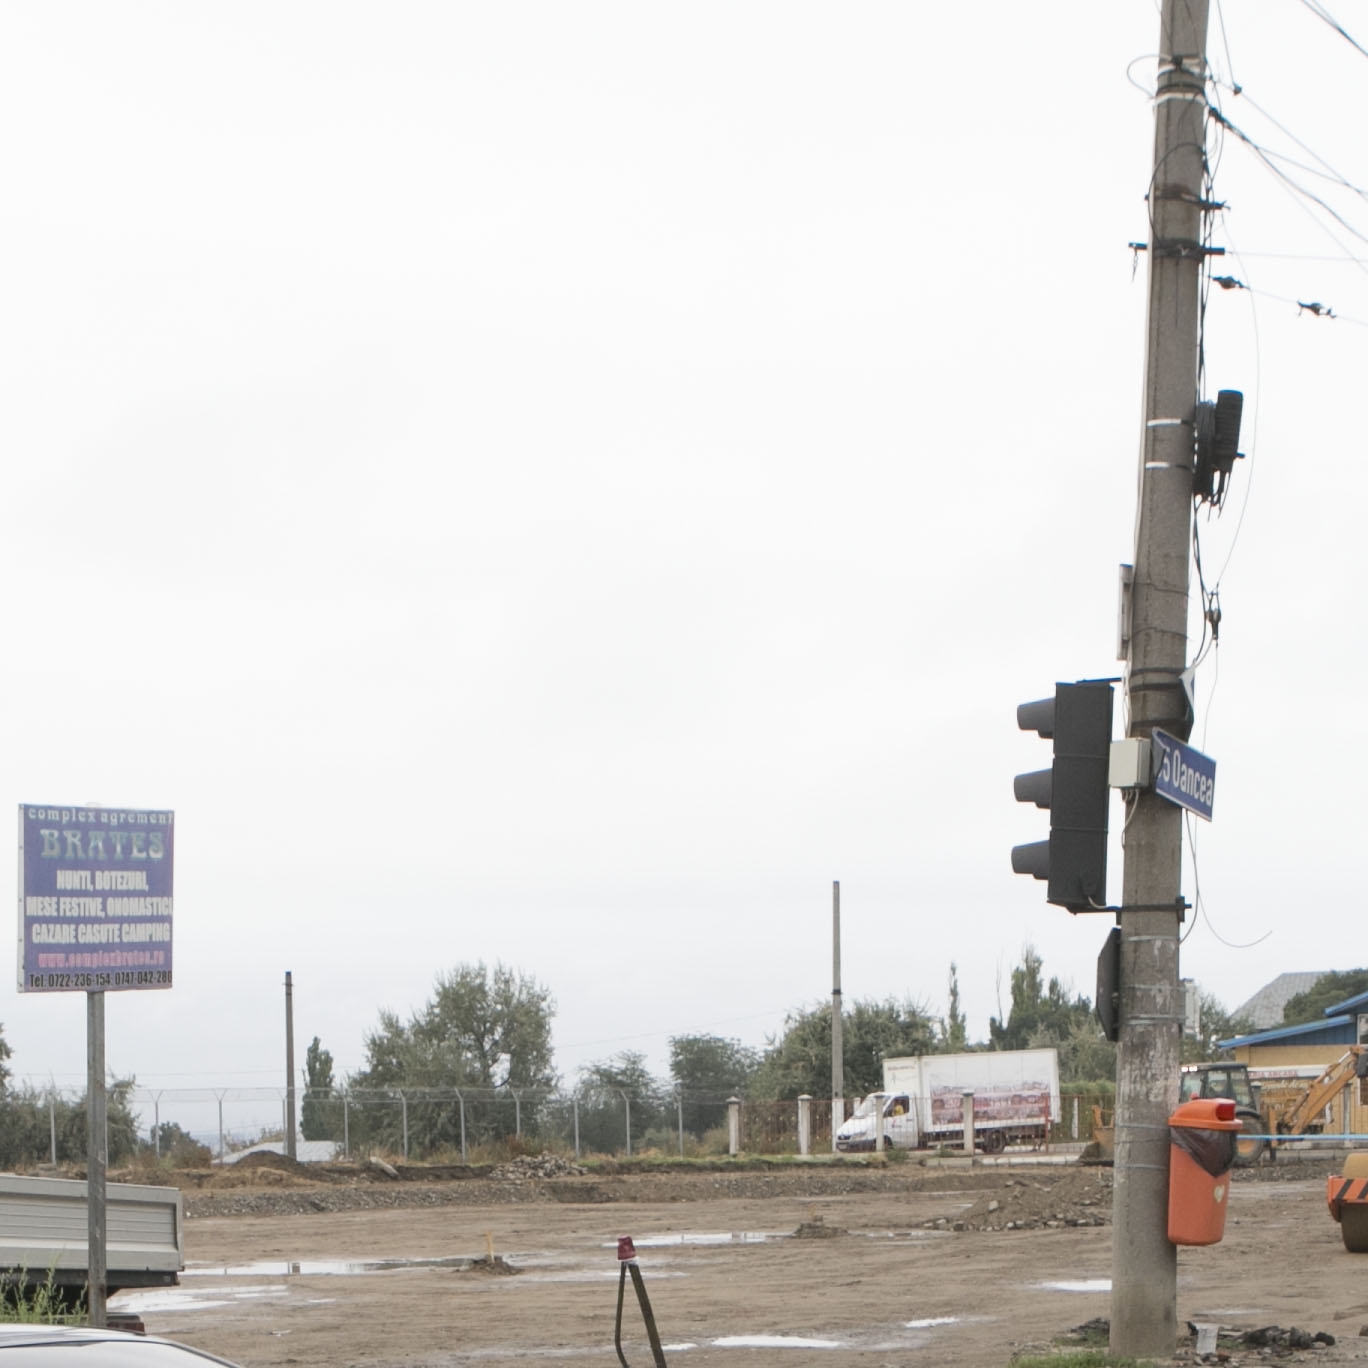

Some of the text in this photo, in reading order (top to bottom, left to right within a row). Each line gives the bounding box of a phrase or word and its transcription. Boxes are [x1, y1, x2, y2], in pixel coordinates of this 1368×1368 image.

[1173, 749, 1212, 807] Oancea
[28, 807, 96, 825] complex
[26, 897, 57, 916] MESE
[32, 924, 76, 944] CAZARE
[122, 923, 170, 942] CAMPING
